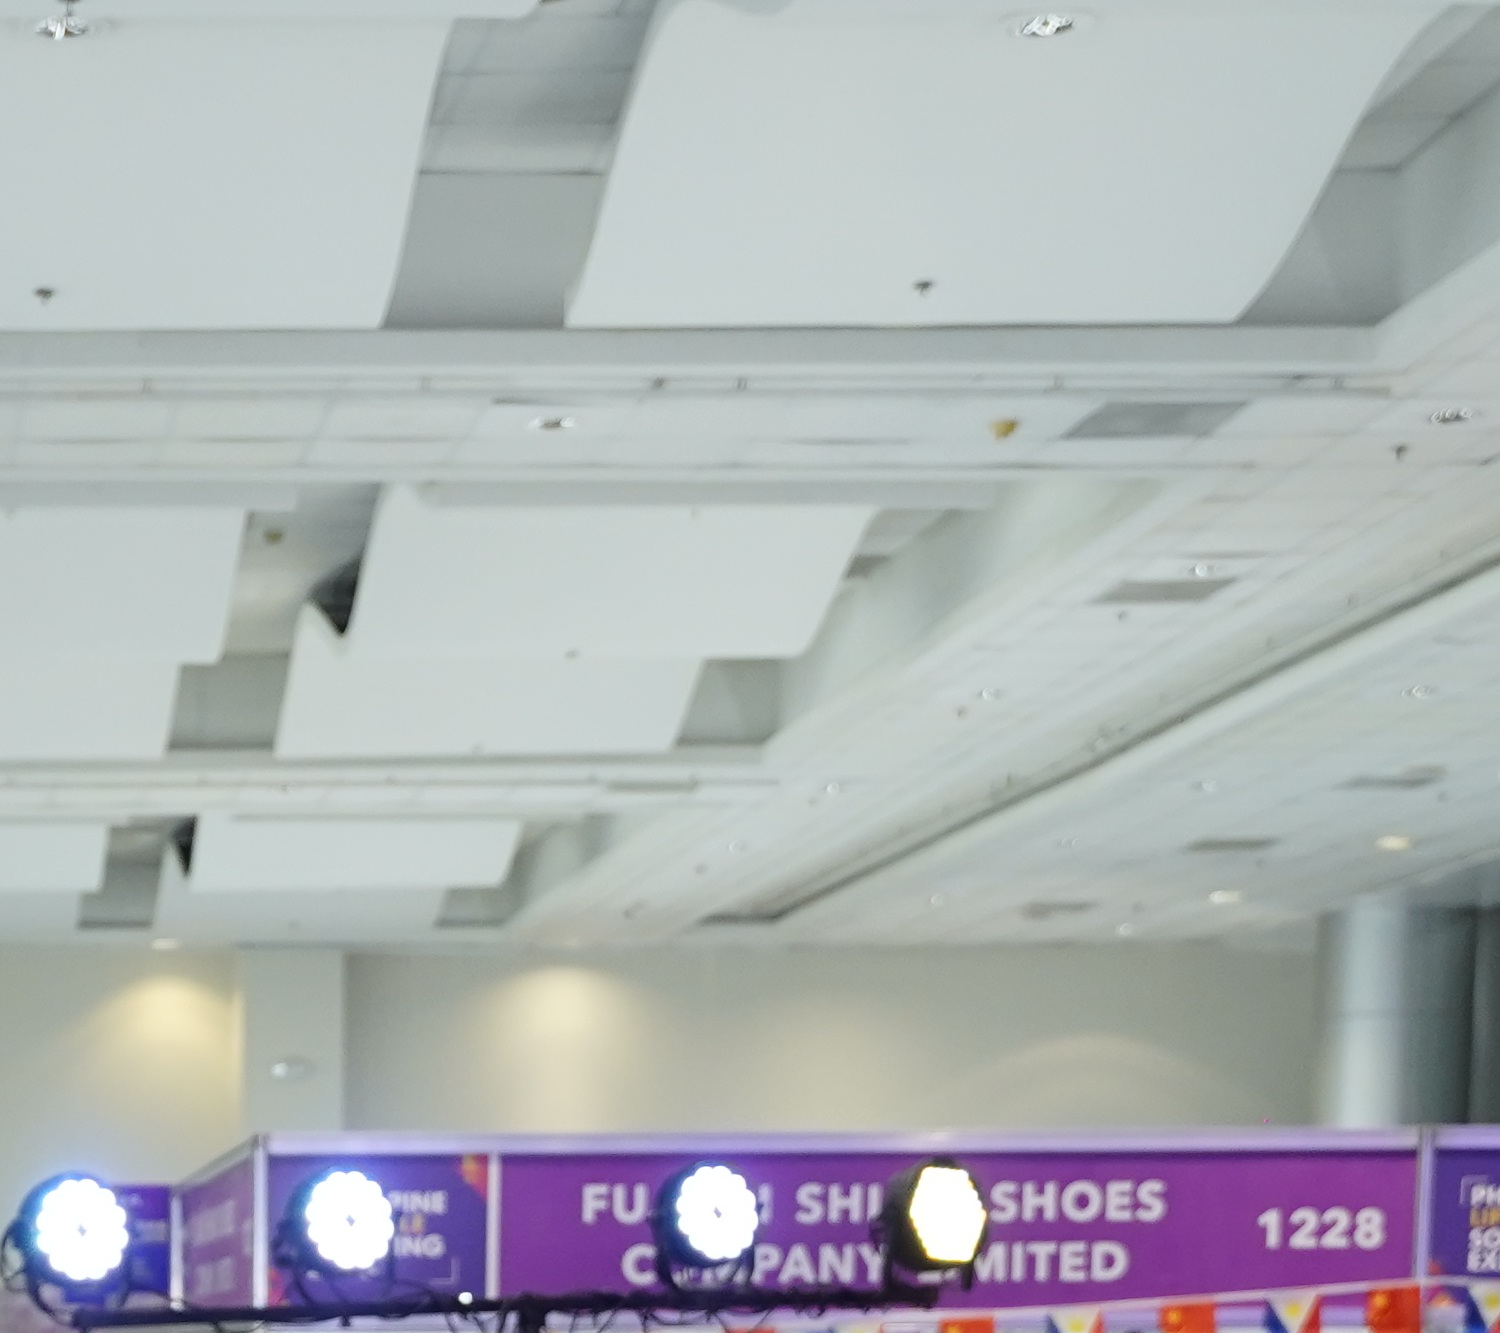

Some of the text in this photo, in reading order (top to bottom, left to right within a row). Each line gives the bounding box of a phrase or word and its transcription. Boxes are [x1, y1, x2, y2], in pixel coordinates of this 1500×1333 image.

[989, 1179, 1168, 1225] SHOES
[1257, 1206, 1386, 1250] 1228
[621, 1243, 887, 1287] CPANY
